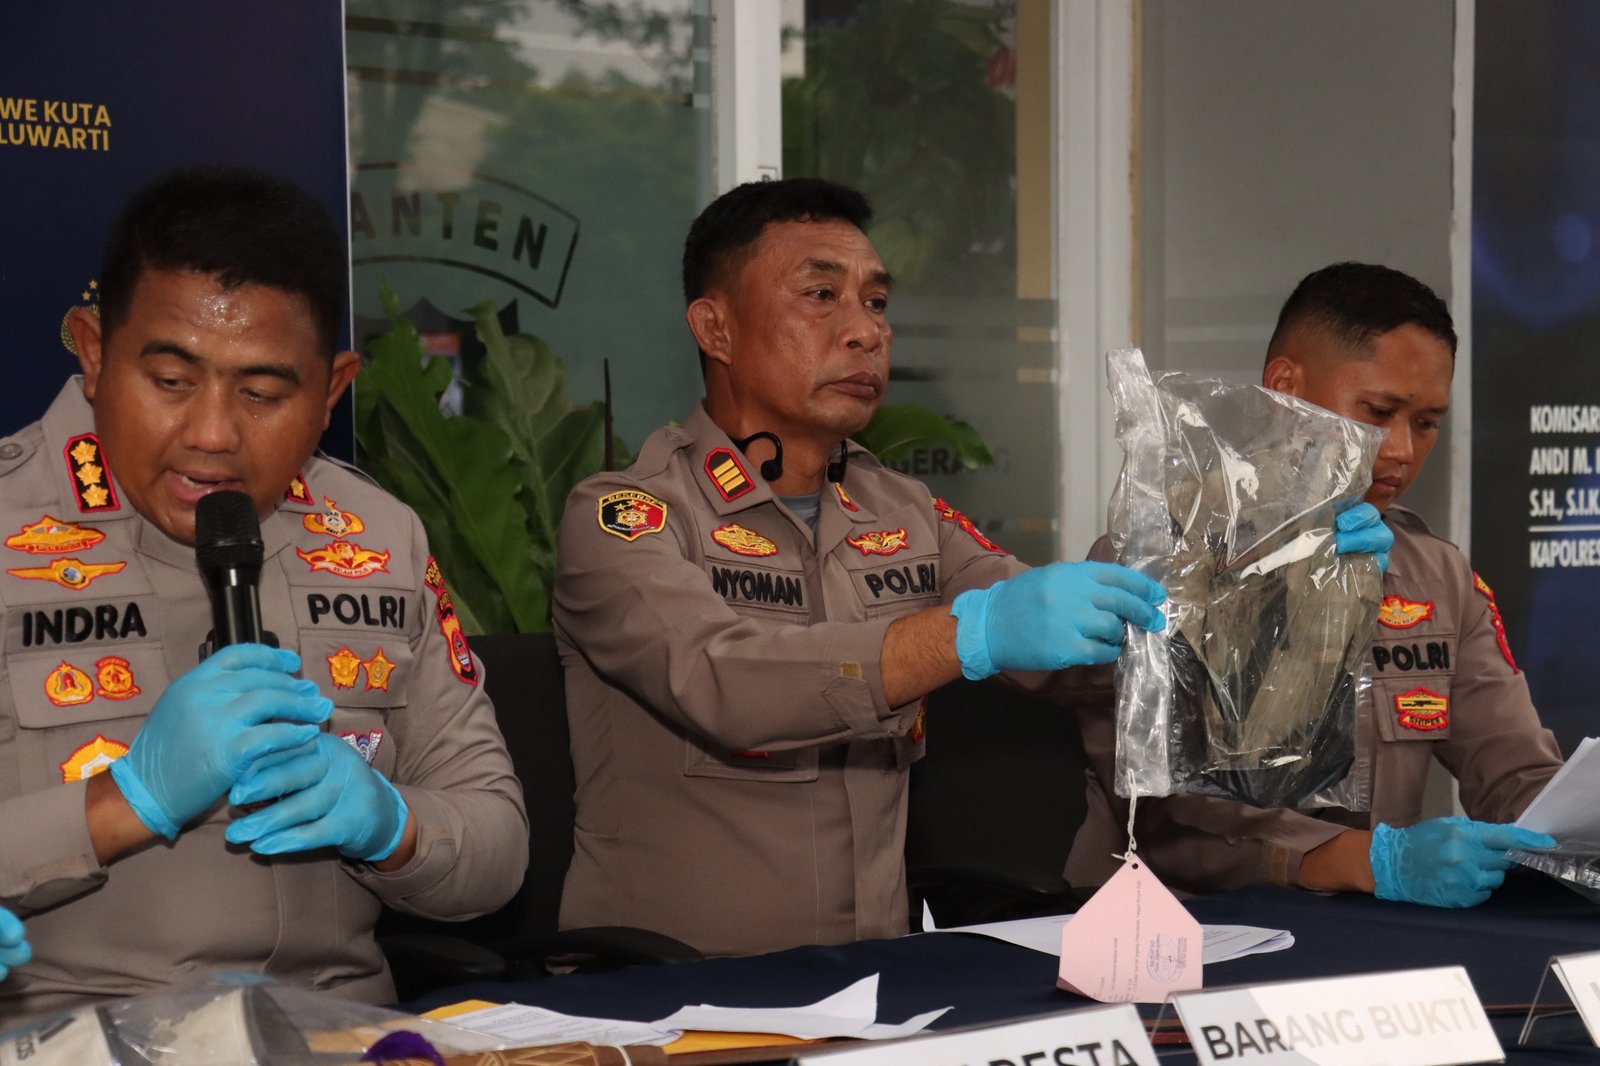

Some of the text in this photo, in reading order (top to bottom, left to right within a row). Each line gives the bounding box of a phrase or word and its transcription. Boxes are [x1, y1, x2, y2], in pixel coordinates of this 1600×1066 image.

[44, 101, 111, 127] KUTA
[1529, 447, 1569, 475] ANDI
[712, 566, 803, 607] NYOMAN
[864, 563, 936, 599] POLRI
[22, 602, 147, 647] INDRA
[307, 593, 406, 628] POLRI
[1372, 641, 1450, 672] POLRI
[1409, 714, 1441, 726] SNIPER
[1201, 997, 1478, 1060] BARANG BUKTI
